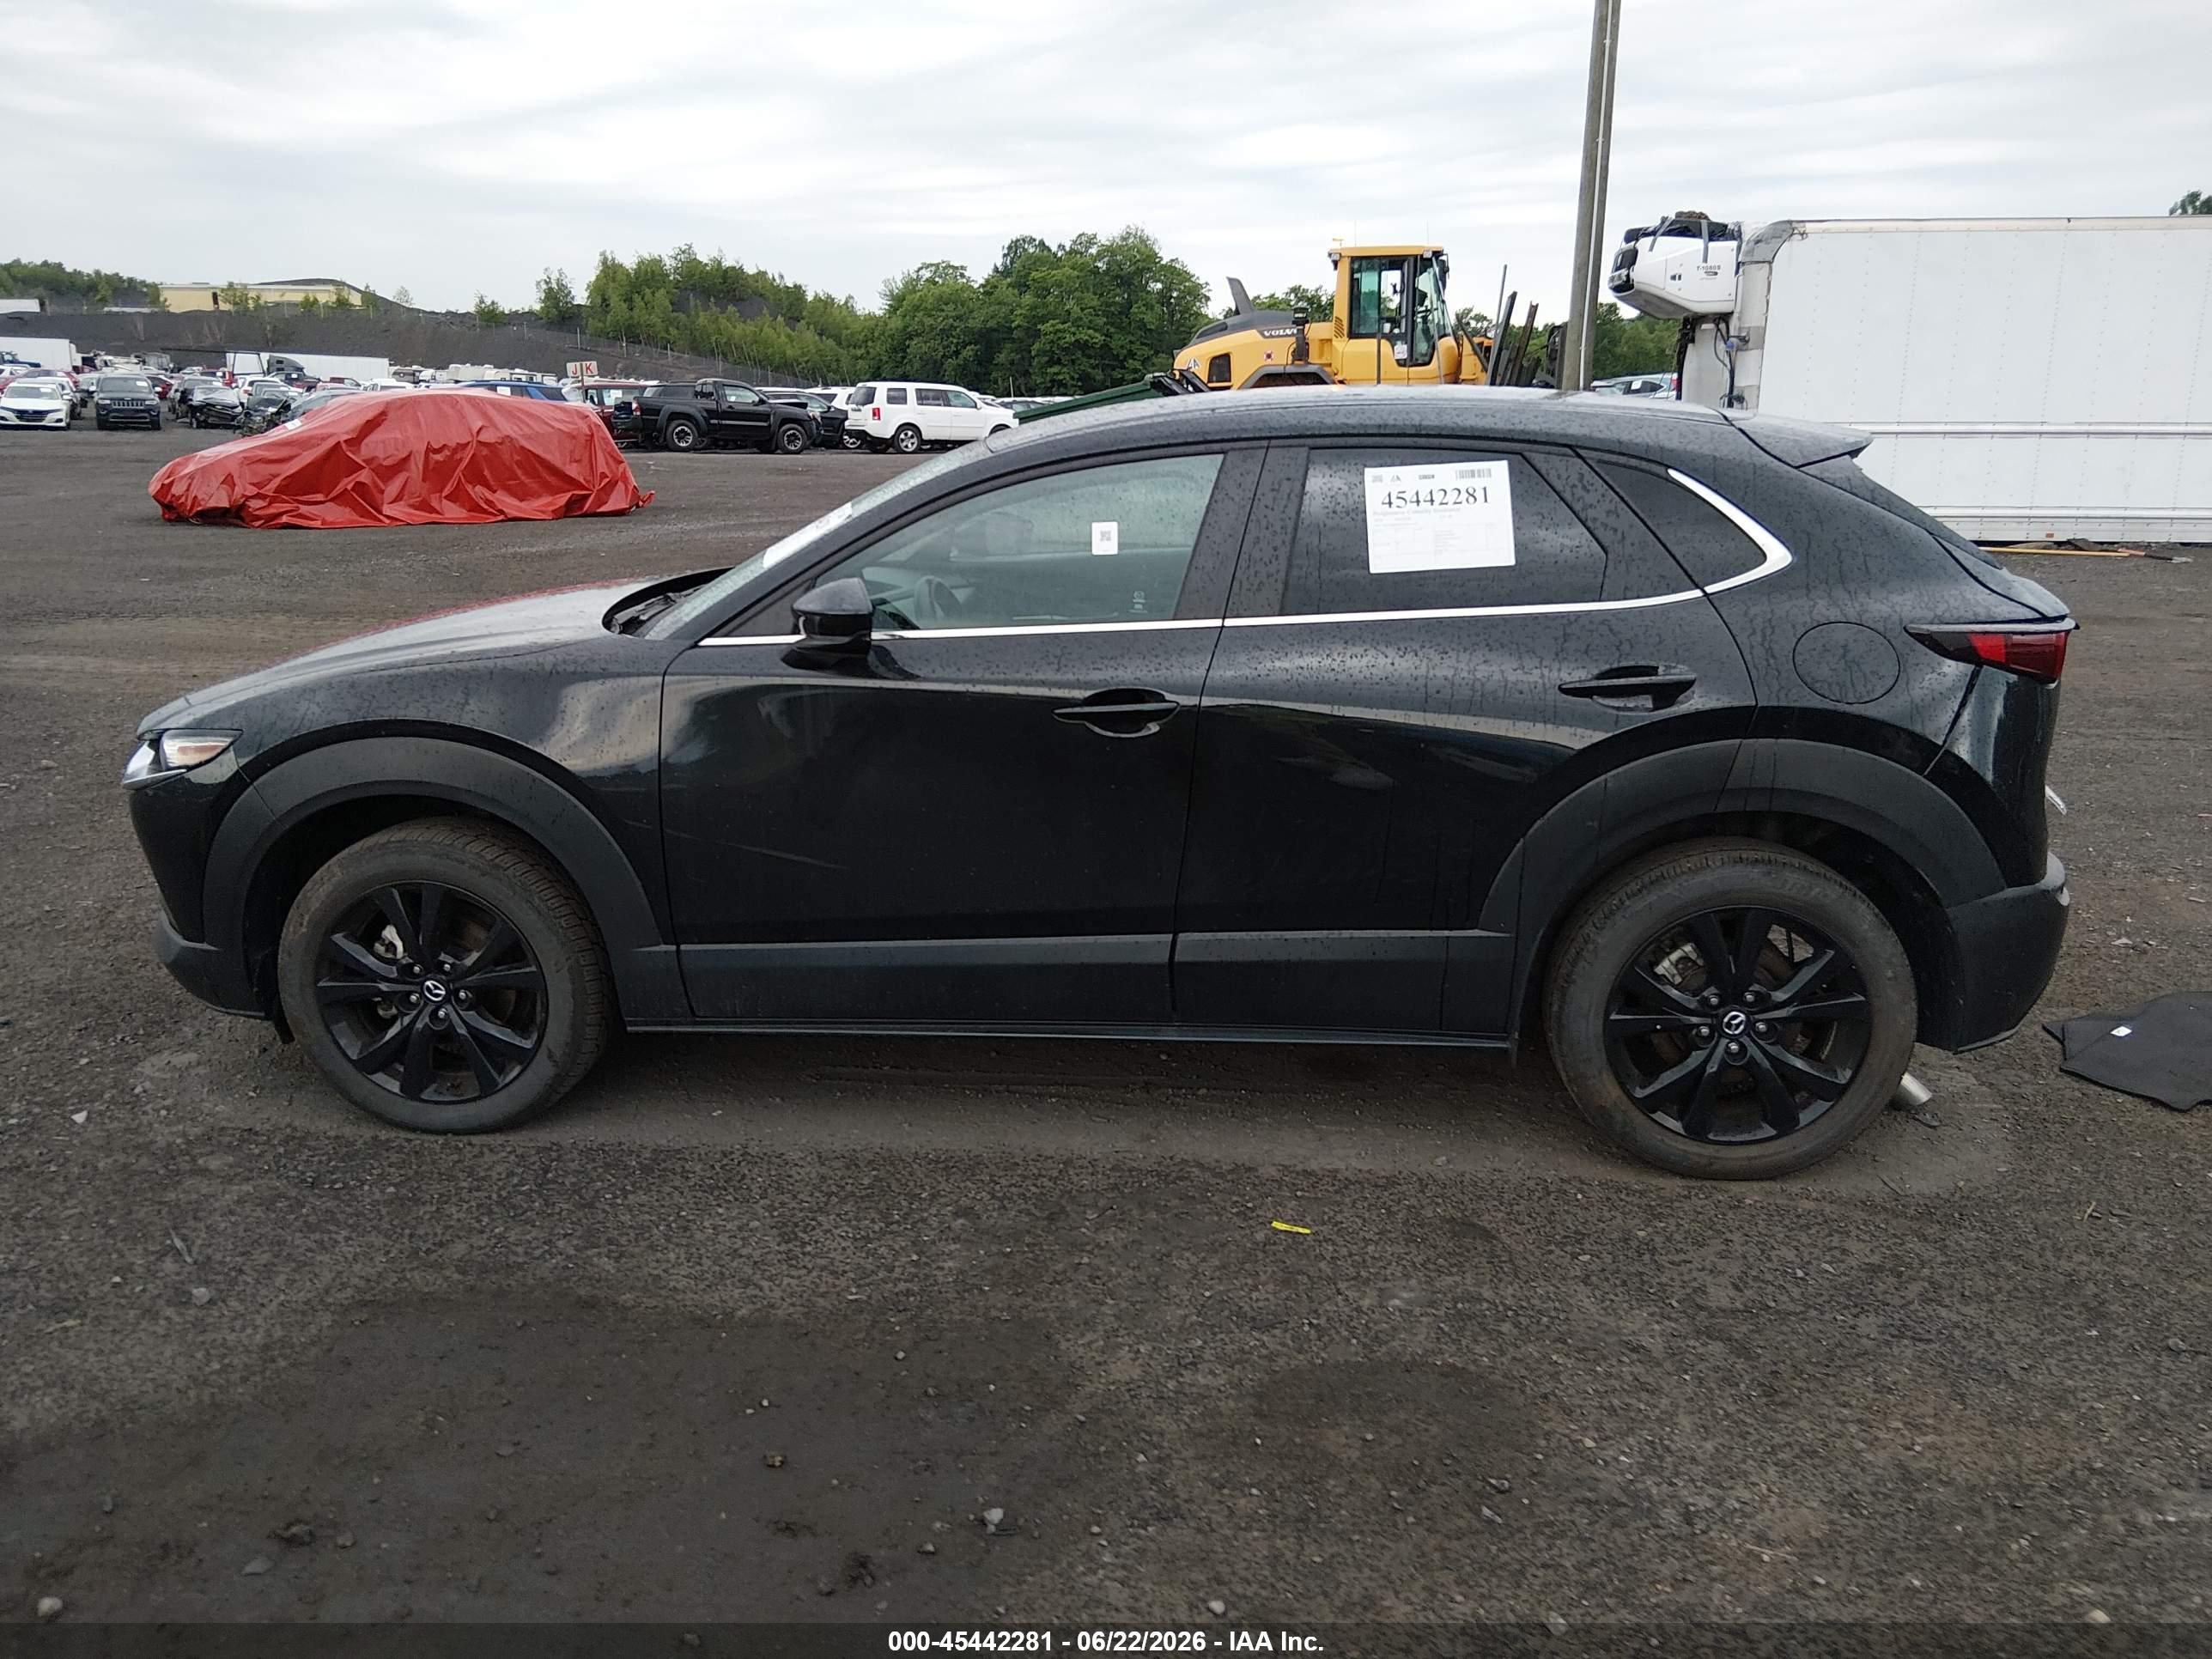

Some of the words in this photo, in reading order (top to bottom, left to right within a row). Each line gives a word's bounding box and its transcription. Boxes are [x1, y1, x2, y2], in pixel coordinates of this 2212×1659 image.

[572, 363, 578, 375] J
[585, 362, 593, 374] K
[1381, 486, 1491, 509] 45442281
